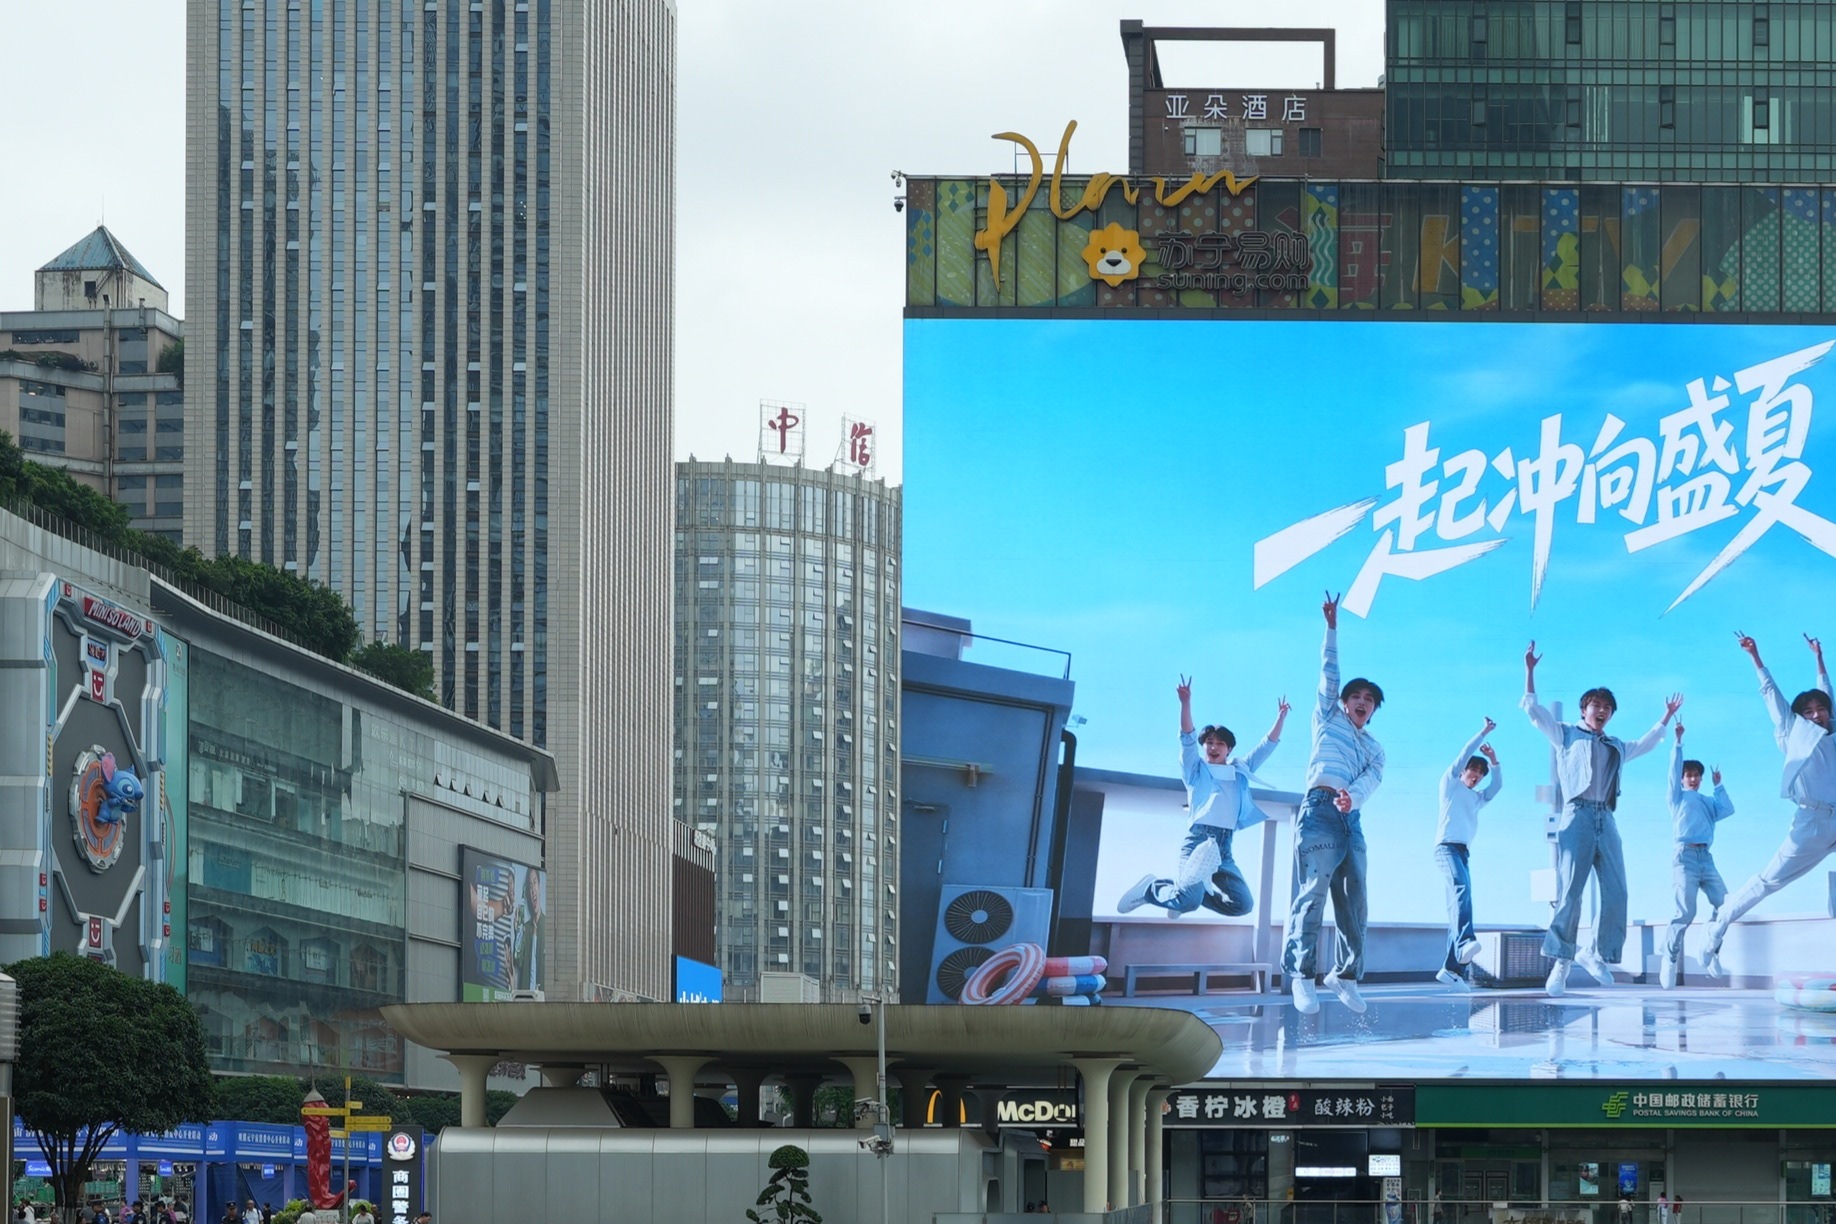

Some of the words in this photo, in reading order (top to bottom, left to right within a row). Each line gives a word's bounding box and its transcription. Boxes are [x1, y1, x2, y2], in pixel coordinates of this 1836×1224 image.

[1165, 94, 1307, 121] 亚朵酒店
[1157, 230, 1309, 270] 苏宁易购
[1157, 272, 1310, 295] suning.com
[768, 406, 873, 466] 中信
[997, 1100, 1076, 1122] McDo
[1176, 1095, 1286, 1118] 香柠冰橙
[1314, 1097, 1375, 1117] 酸辣粉
[1633, 1093, 1759, 1109] 中国邮政储蓄银行
